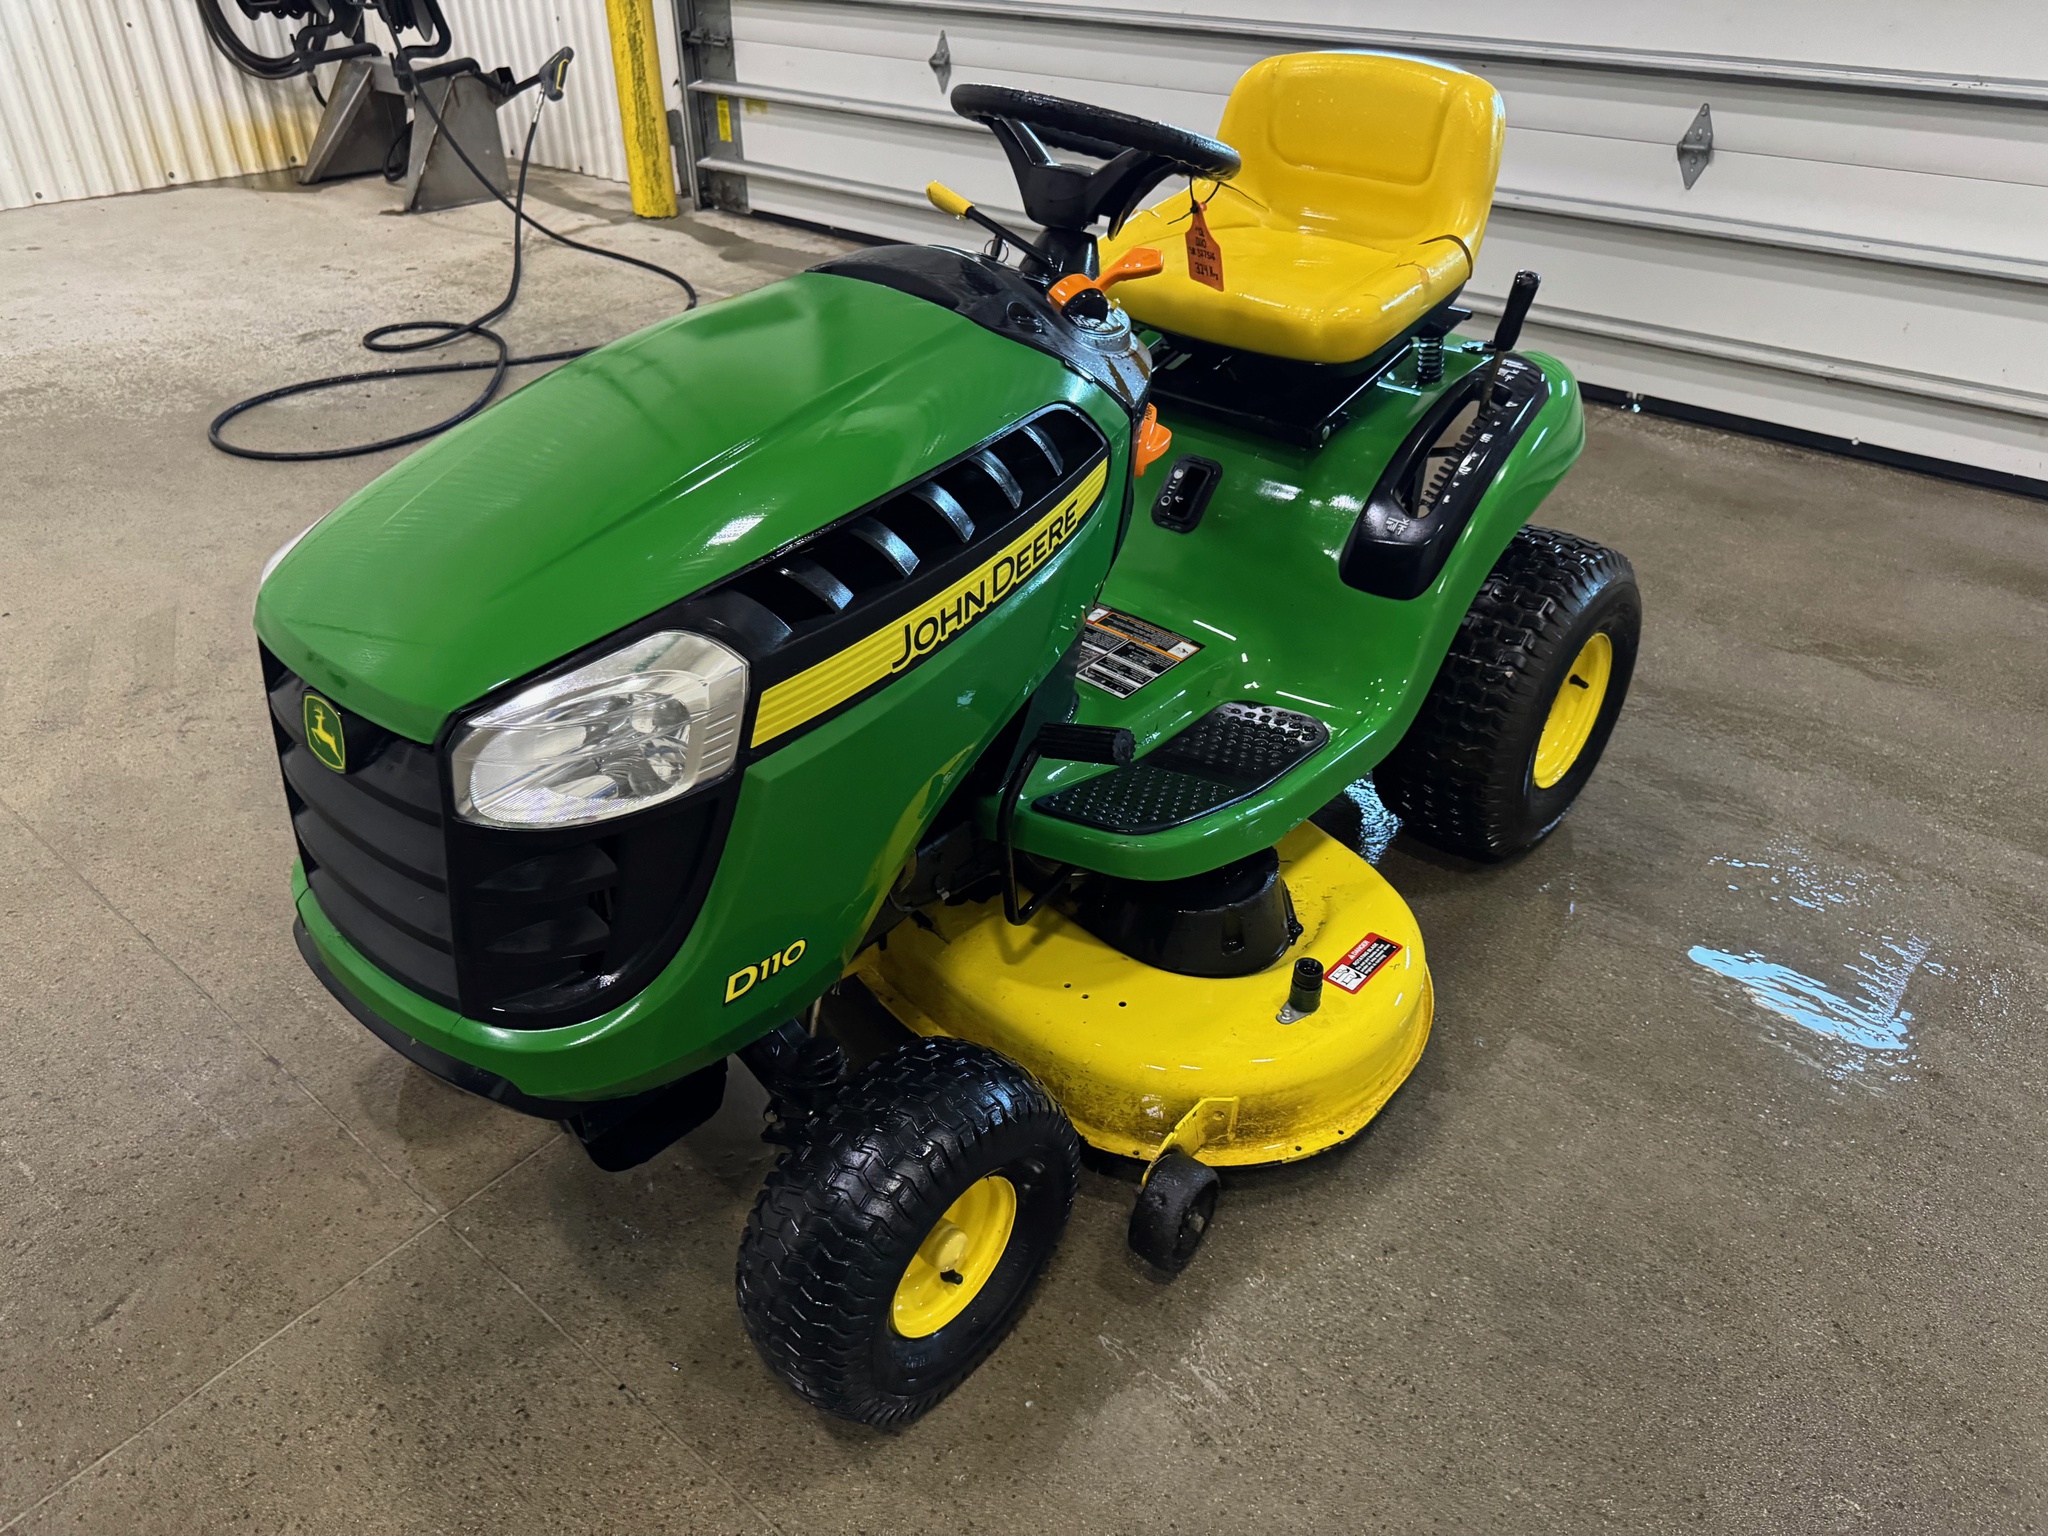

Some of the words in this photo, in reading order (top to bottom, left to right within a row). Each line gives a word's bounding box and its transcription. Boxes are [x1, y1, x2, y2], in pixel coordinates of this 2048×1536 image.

[892, 580, 986, 669] JOHN
[993, 499, 1078, 598] DEERE
[1351, 940, 1370, 955] DANGER
[1367, 943, 1379, 952] BLADE
[725, 940, 806, 1004] D110
